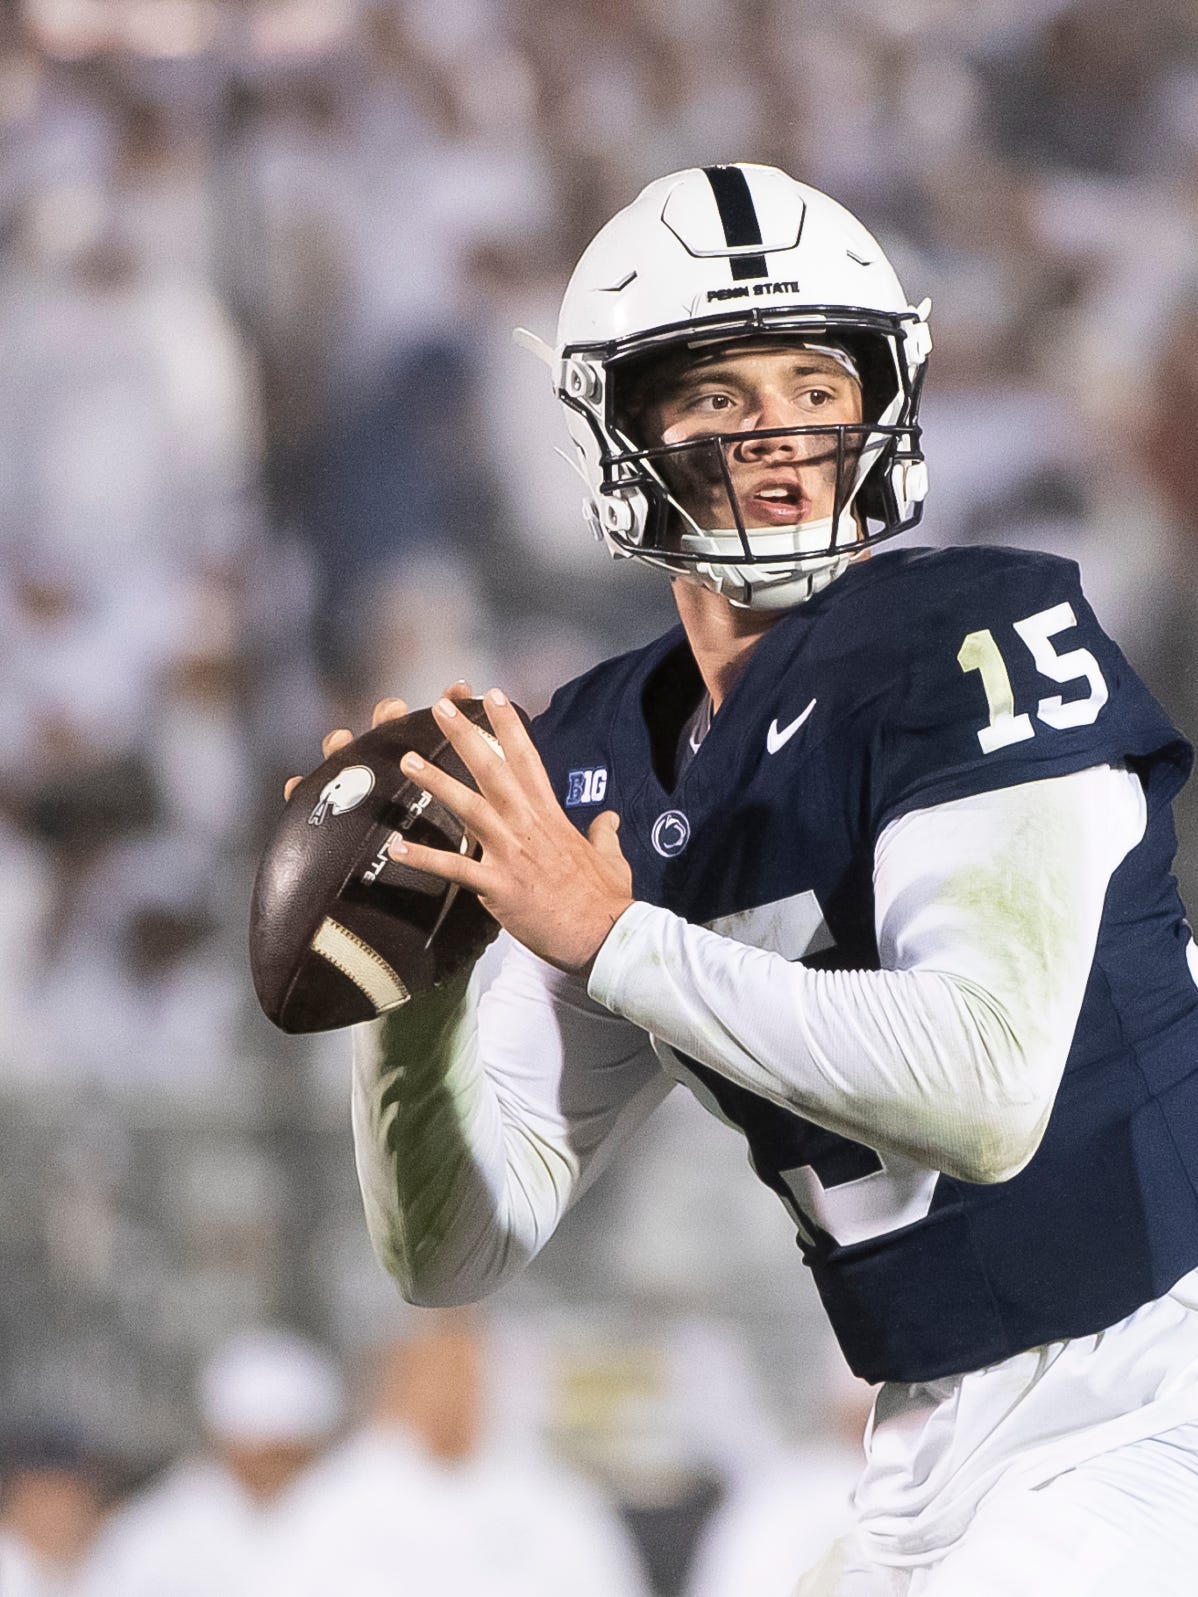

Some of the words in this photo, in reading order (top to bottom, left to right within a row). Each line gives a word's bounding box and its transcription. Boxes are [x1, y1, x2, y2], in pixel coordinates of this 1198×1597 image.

[707, 286, 749, 302] PENN
[753, 281, 800, 295] STATE
[957, 601, 1108, 754] 15
[401, 790, 433, 830] POR
